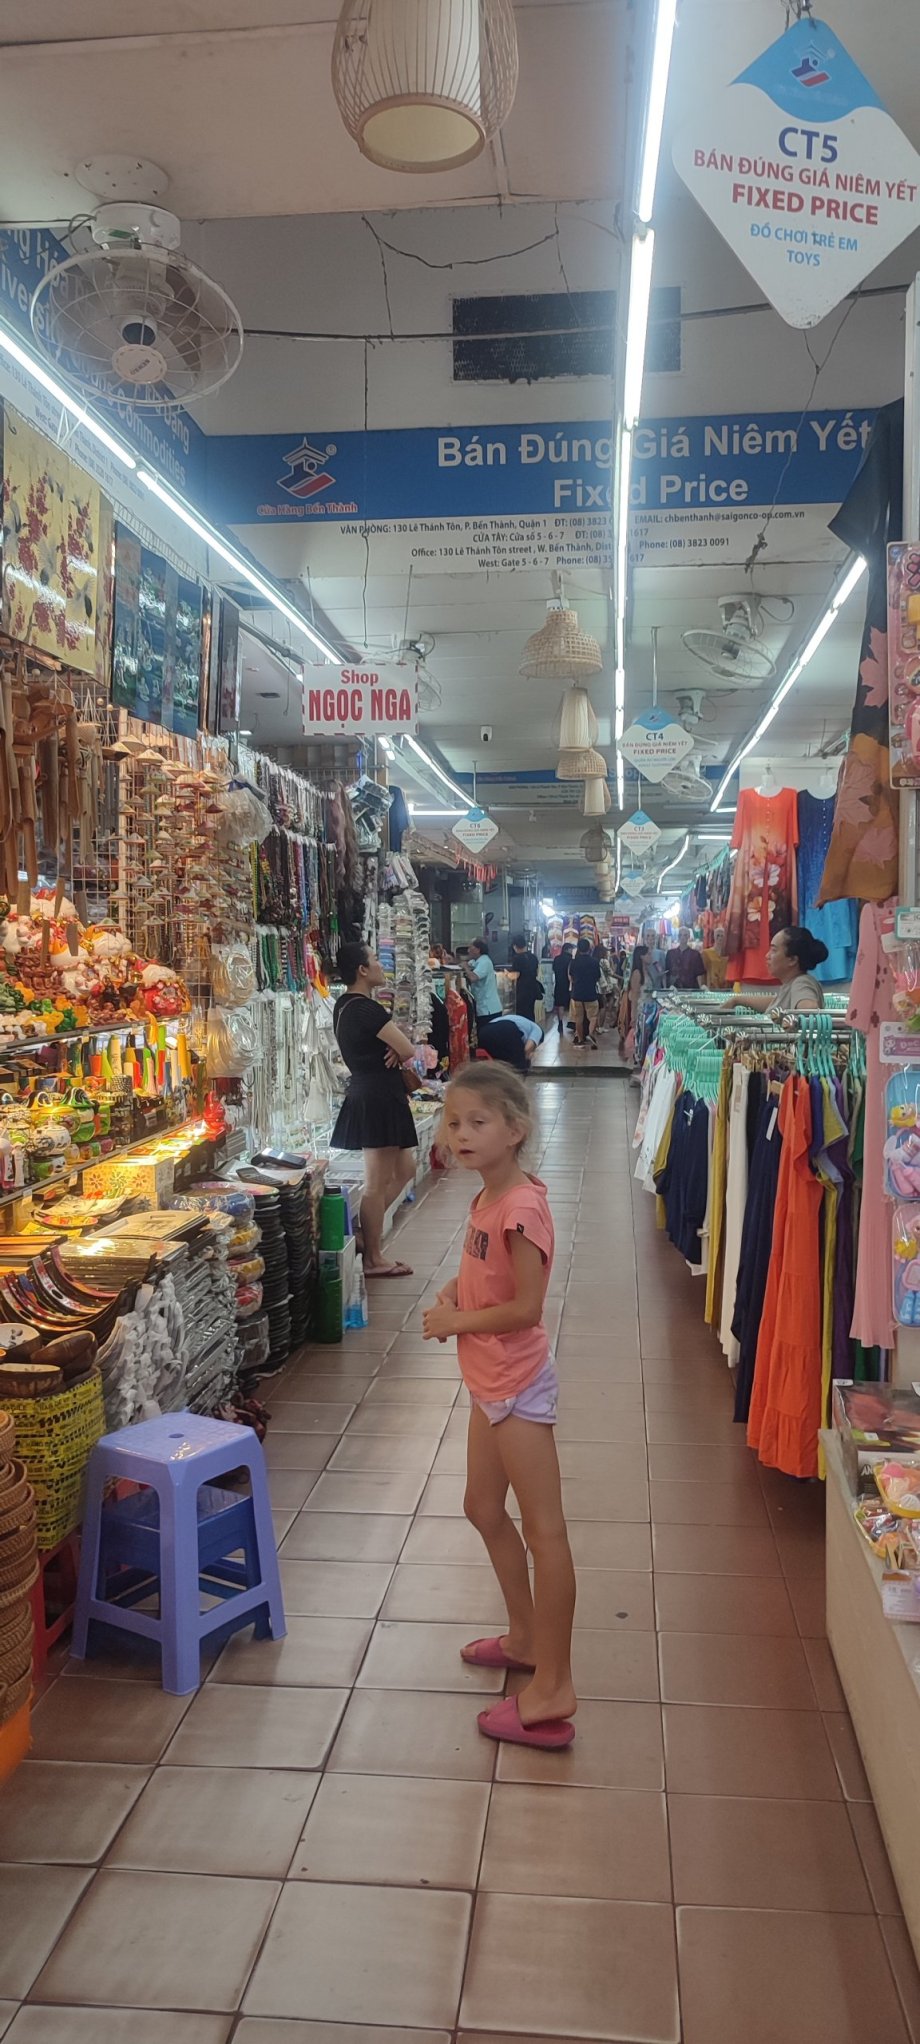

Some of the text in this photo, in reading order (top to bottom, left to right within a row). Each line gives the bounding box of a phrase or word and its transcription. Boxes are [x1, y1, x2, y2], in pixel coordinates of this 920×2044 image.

[778, 127, 838, 163] CT5
[694, 149, 917, 202] BÁN ĐÚNG GIÁ NIÊM YẾT
[732, 183, 879, 226] FIXED PRICE
[774, 226, 808, 244] CHƠI
[838, 236, 858, 252] EM
[786, 249, 821, 267] TOYS
[437, 412, 871, 468] Bán Đúng Giá Niêm Yết
[659, 474, 748, 503] Price
[278, 504, 304, 517] Hàng
[326, 501, 358, 513] Thành
[340, 524, 357, 535] VĂN
[360, 524, 391, 534] PHÒNG:
[393, 524, 407, 533] 130
[409, 523, 418, 532] Lê
[420, 522, 444, 532] Thánh
[446, 522, 463, 532] Tôn,
[465, 522, 471, 531] P.
[473, 519, 487, 530] Bến
[489, 519, 517, 530] Thành,
[519, 519, 539, 530] Quận
[543, 519, 547, 528] 1
[554, 518, 568, 527] ĐT:
[569, 517, 586, 527] (08)
[587, 517, 607, 526] 3823
[635, 514, 663, 524] EMAIL:
[473, 530, 490, 542] CỬA
[492, 531, 508, 541] TÂY:
[509, 531, 524, 541] Cửa
[536, 532, 541, 541] 5
[548, 531, 553, 540] 6
[559, 531, 564, 540] 7
[575, 530, 588, 540] ĐT:
[590, 529, 606, 540] (08)
[411, 548, 437, 557] Office:
[439, 547, 453, 556] 130
[455, 547, 464, 556] Lê
[466, 545, 491, 555] Thánh
[492, 545, 507, 555] Tôn
[537, 544, 547, 553] W.
[549, 543, 564, 553] Bến
[566, 542, 593, 553] Thành,
[639, 540, 668, 549] Phone:
[669, 539, 686, 549] (08)
[687, 538, 707, 547] 3823
[710, 537, 729, 547] 0091
[478, 558, 500, 568] West:
[501, 557, 520, 567] Gate
[522, 557, 527, 566] 5
[533, 557, 538, 566] 6
[544, 556, 549, 565] 7
[556, 556, 584, 565] Phone:
[585, 555, 601, 565] (08)
[341, 669, 379, 686] Shop
[308, 688, 411, 729] NGỌC NGA
[646, 732, 664, 741] CT4
